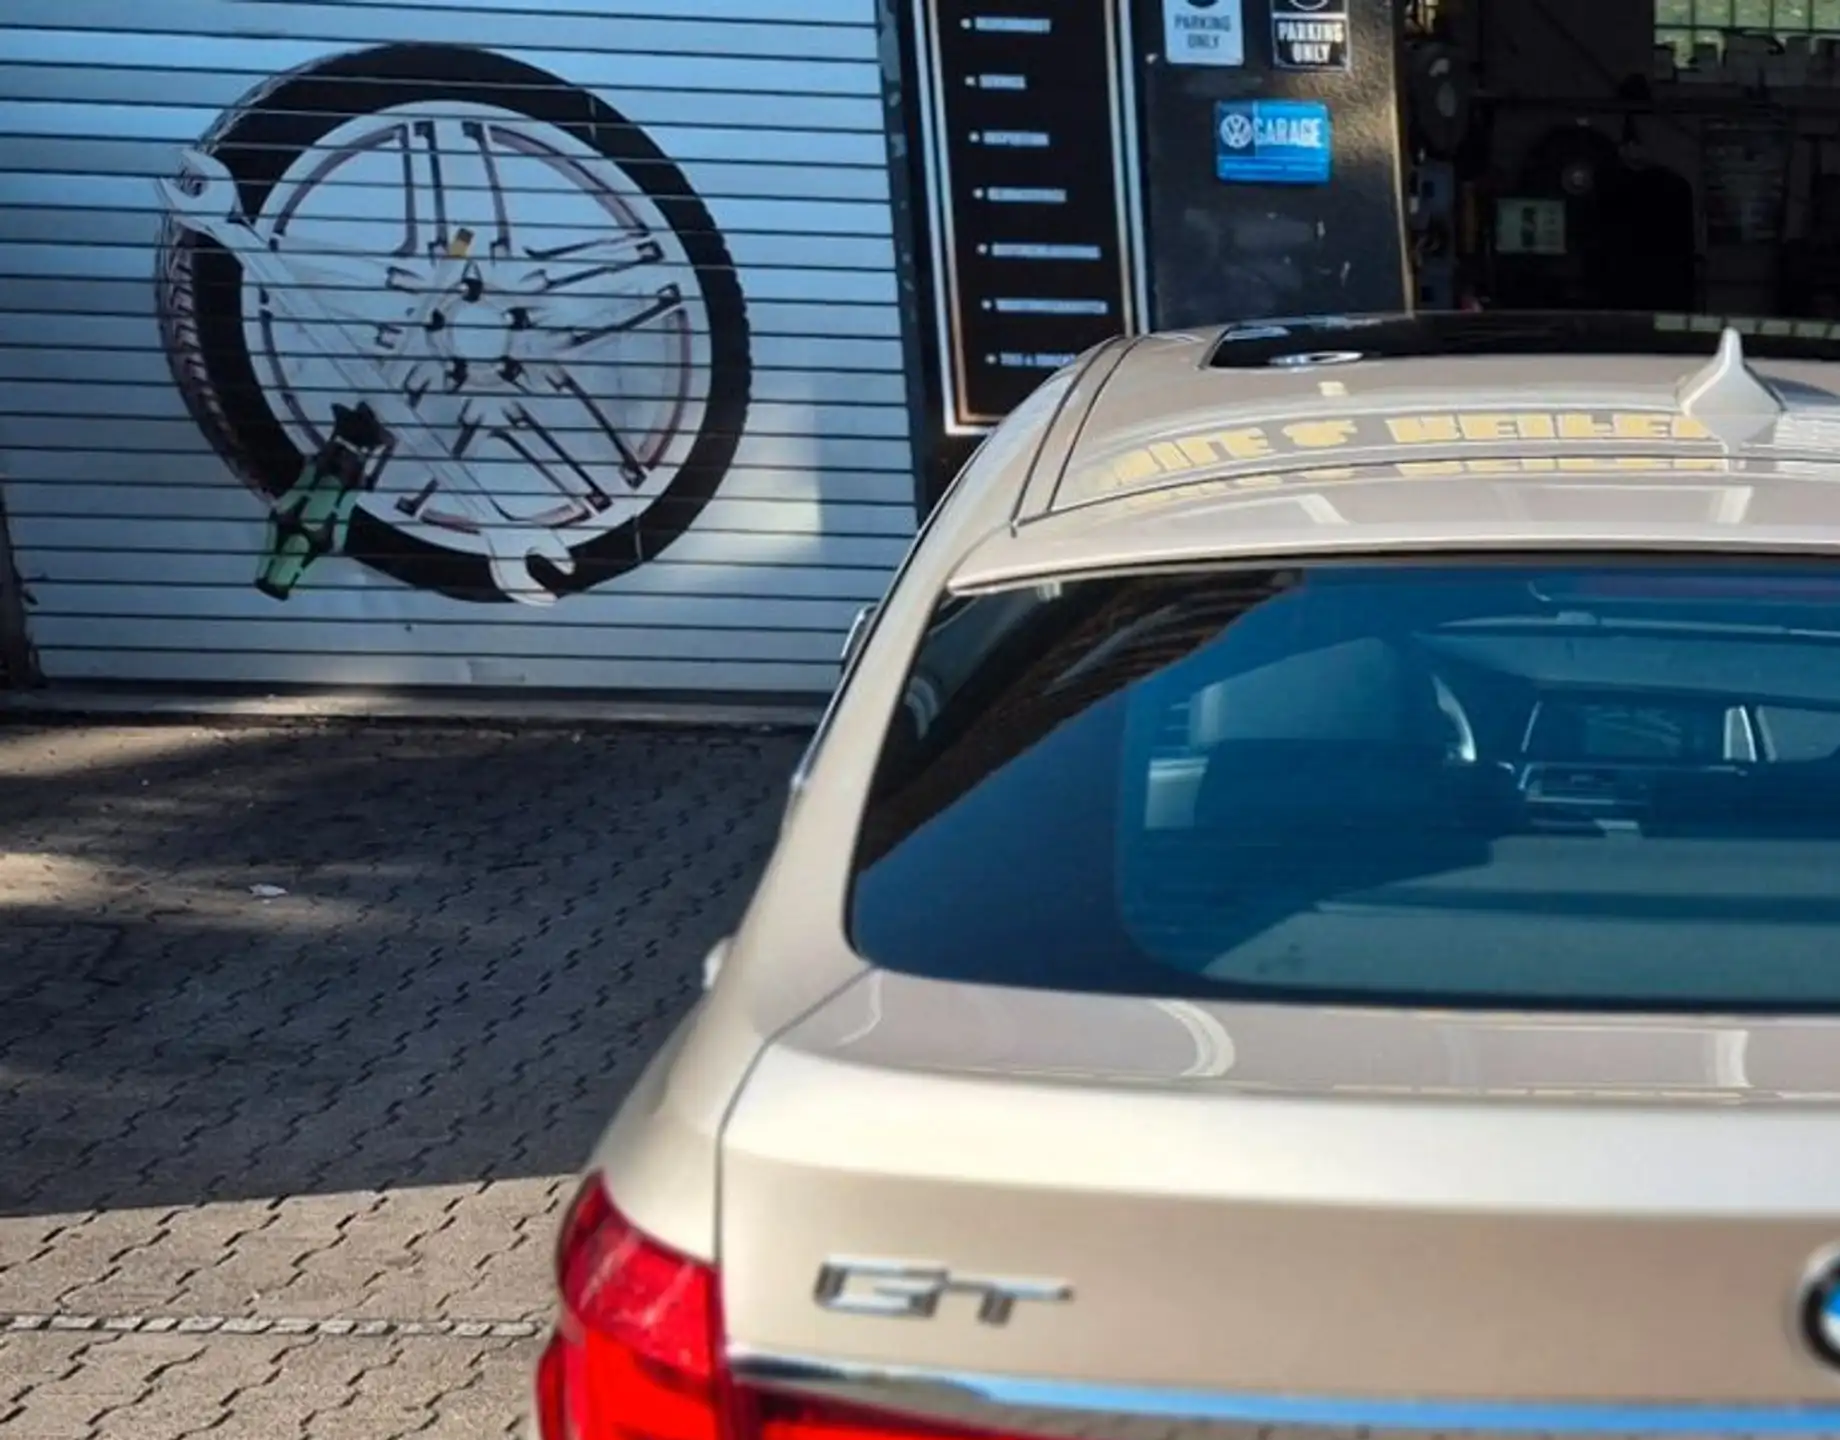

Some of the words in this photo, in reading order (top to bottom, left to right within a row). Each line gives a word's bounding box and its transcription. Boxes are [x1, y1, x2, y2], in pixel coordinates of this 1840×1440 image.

[1174, 15, 1232, 32] PARKING
[1278, 21, 1345, 42] PARKING
[1187, 33, 1221, 49] ONLY
[1292, 43, 1332, 64] ONLY
[1253, 117, 1323, 148] GARAGE
[812, 1253, 1077, 1328] GT
